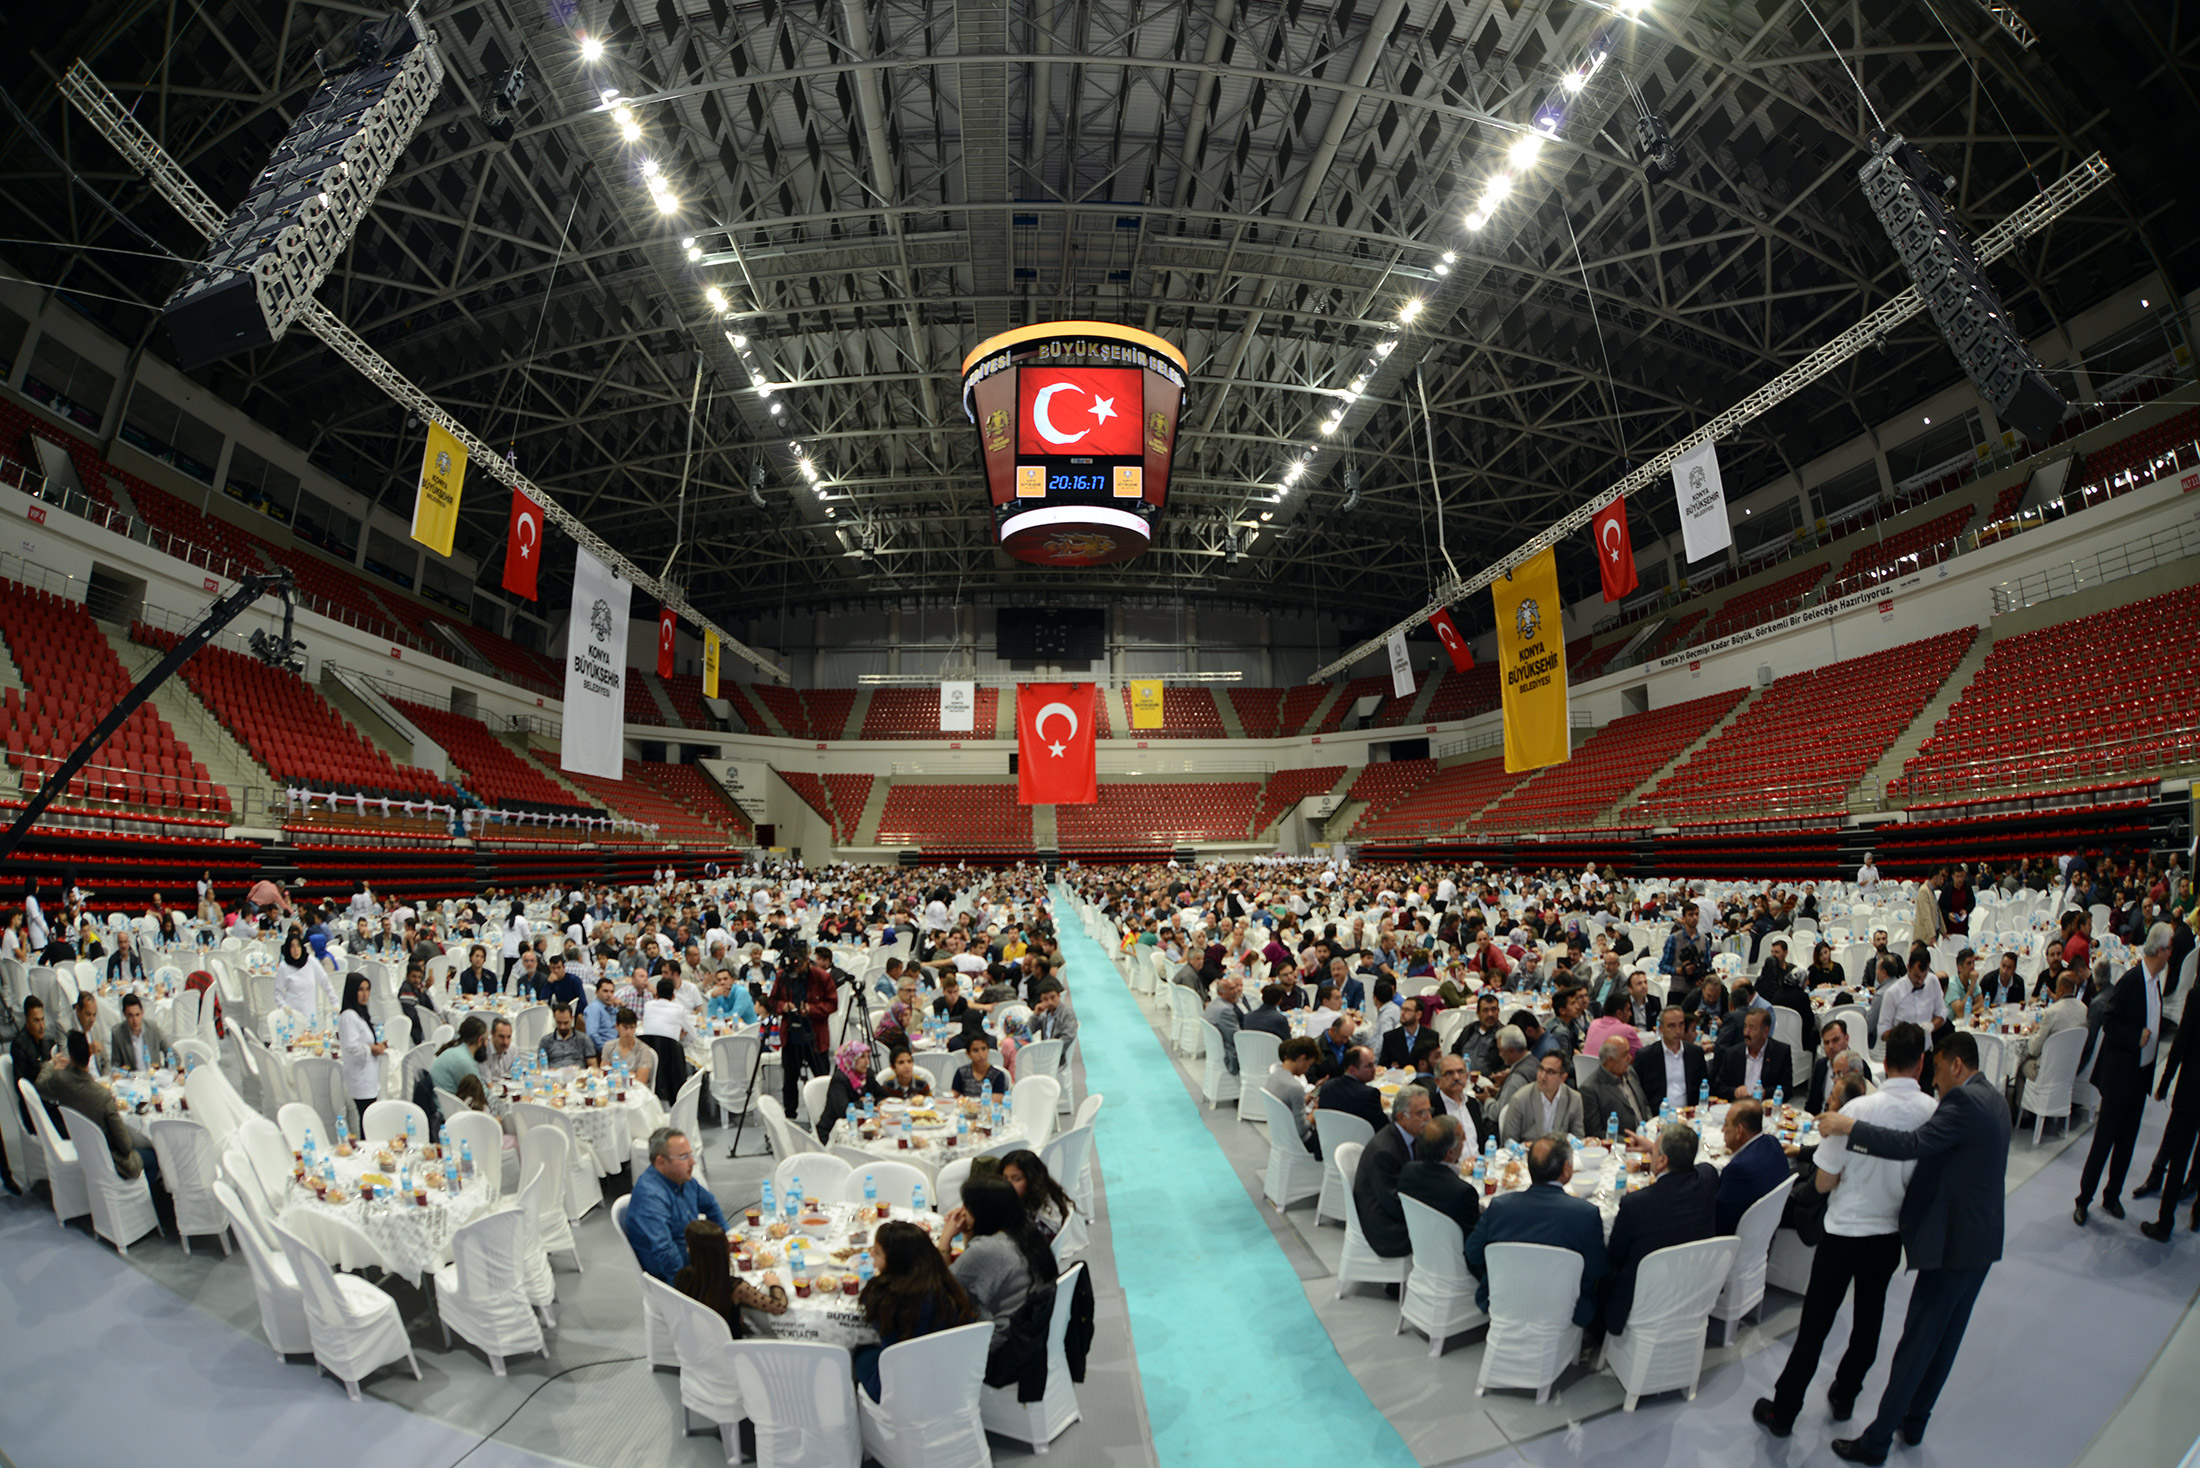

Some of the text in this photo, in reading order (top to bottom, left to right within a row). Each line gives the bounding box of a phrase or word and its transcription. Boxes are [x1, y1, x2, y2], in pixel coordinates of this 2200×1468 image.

[1039, 340, 1148, 367] BÜYÜKŞEHİR
[1048, 475, 1105, 490] 20:16:17
[1660, 585, 1894, 668] Konya'yı Geçmişi Kadar Büyük, Görkemli Bir Geleceğe Hazırlıyoruz.
[588, 644, 611, 666] KONYA
[1518, 641, 1545, 662] KONYA
[574, 655, 620, 690] BÜYÜKŞEHİR
[1508, 651, 1559, 685] BÜYÜKŞEHİR
[1519, 673, 1551, 694] BELEDİYESİ
